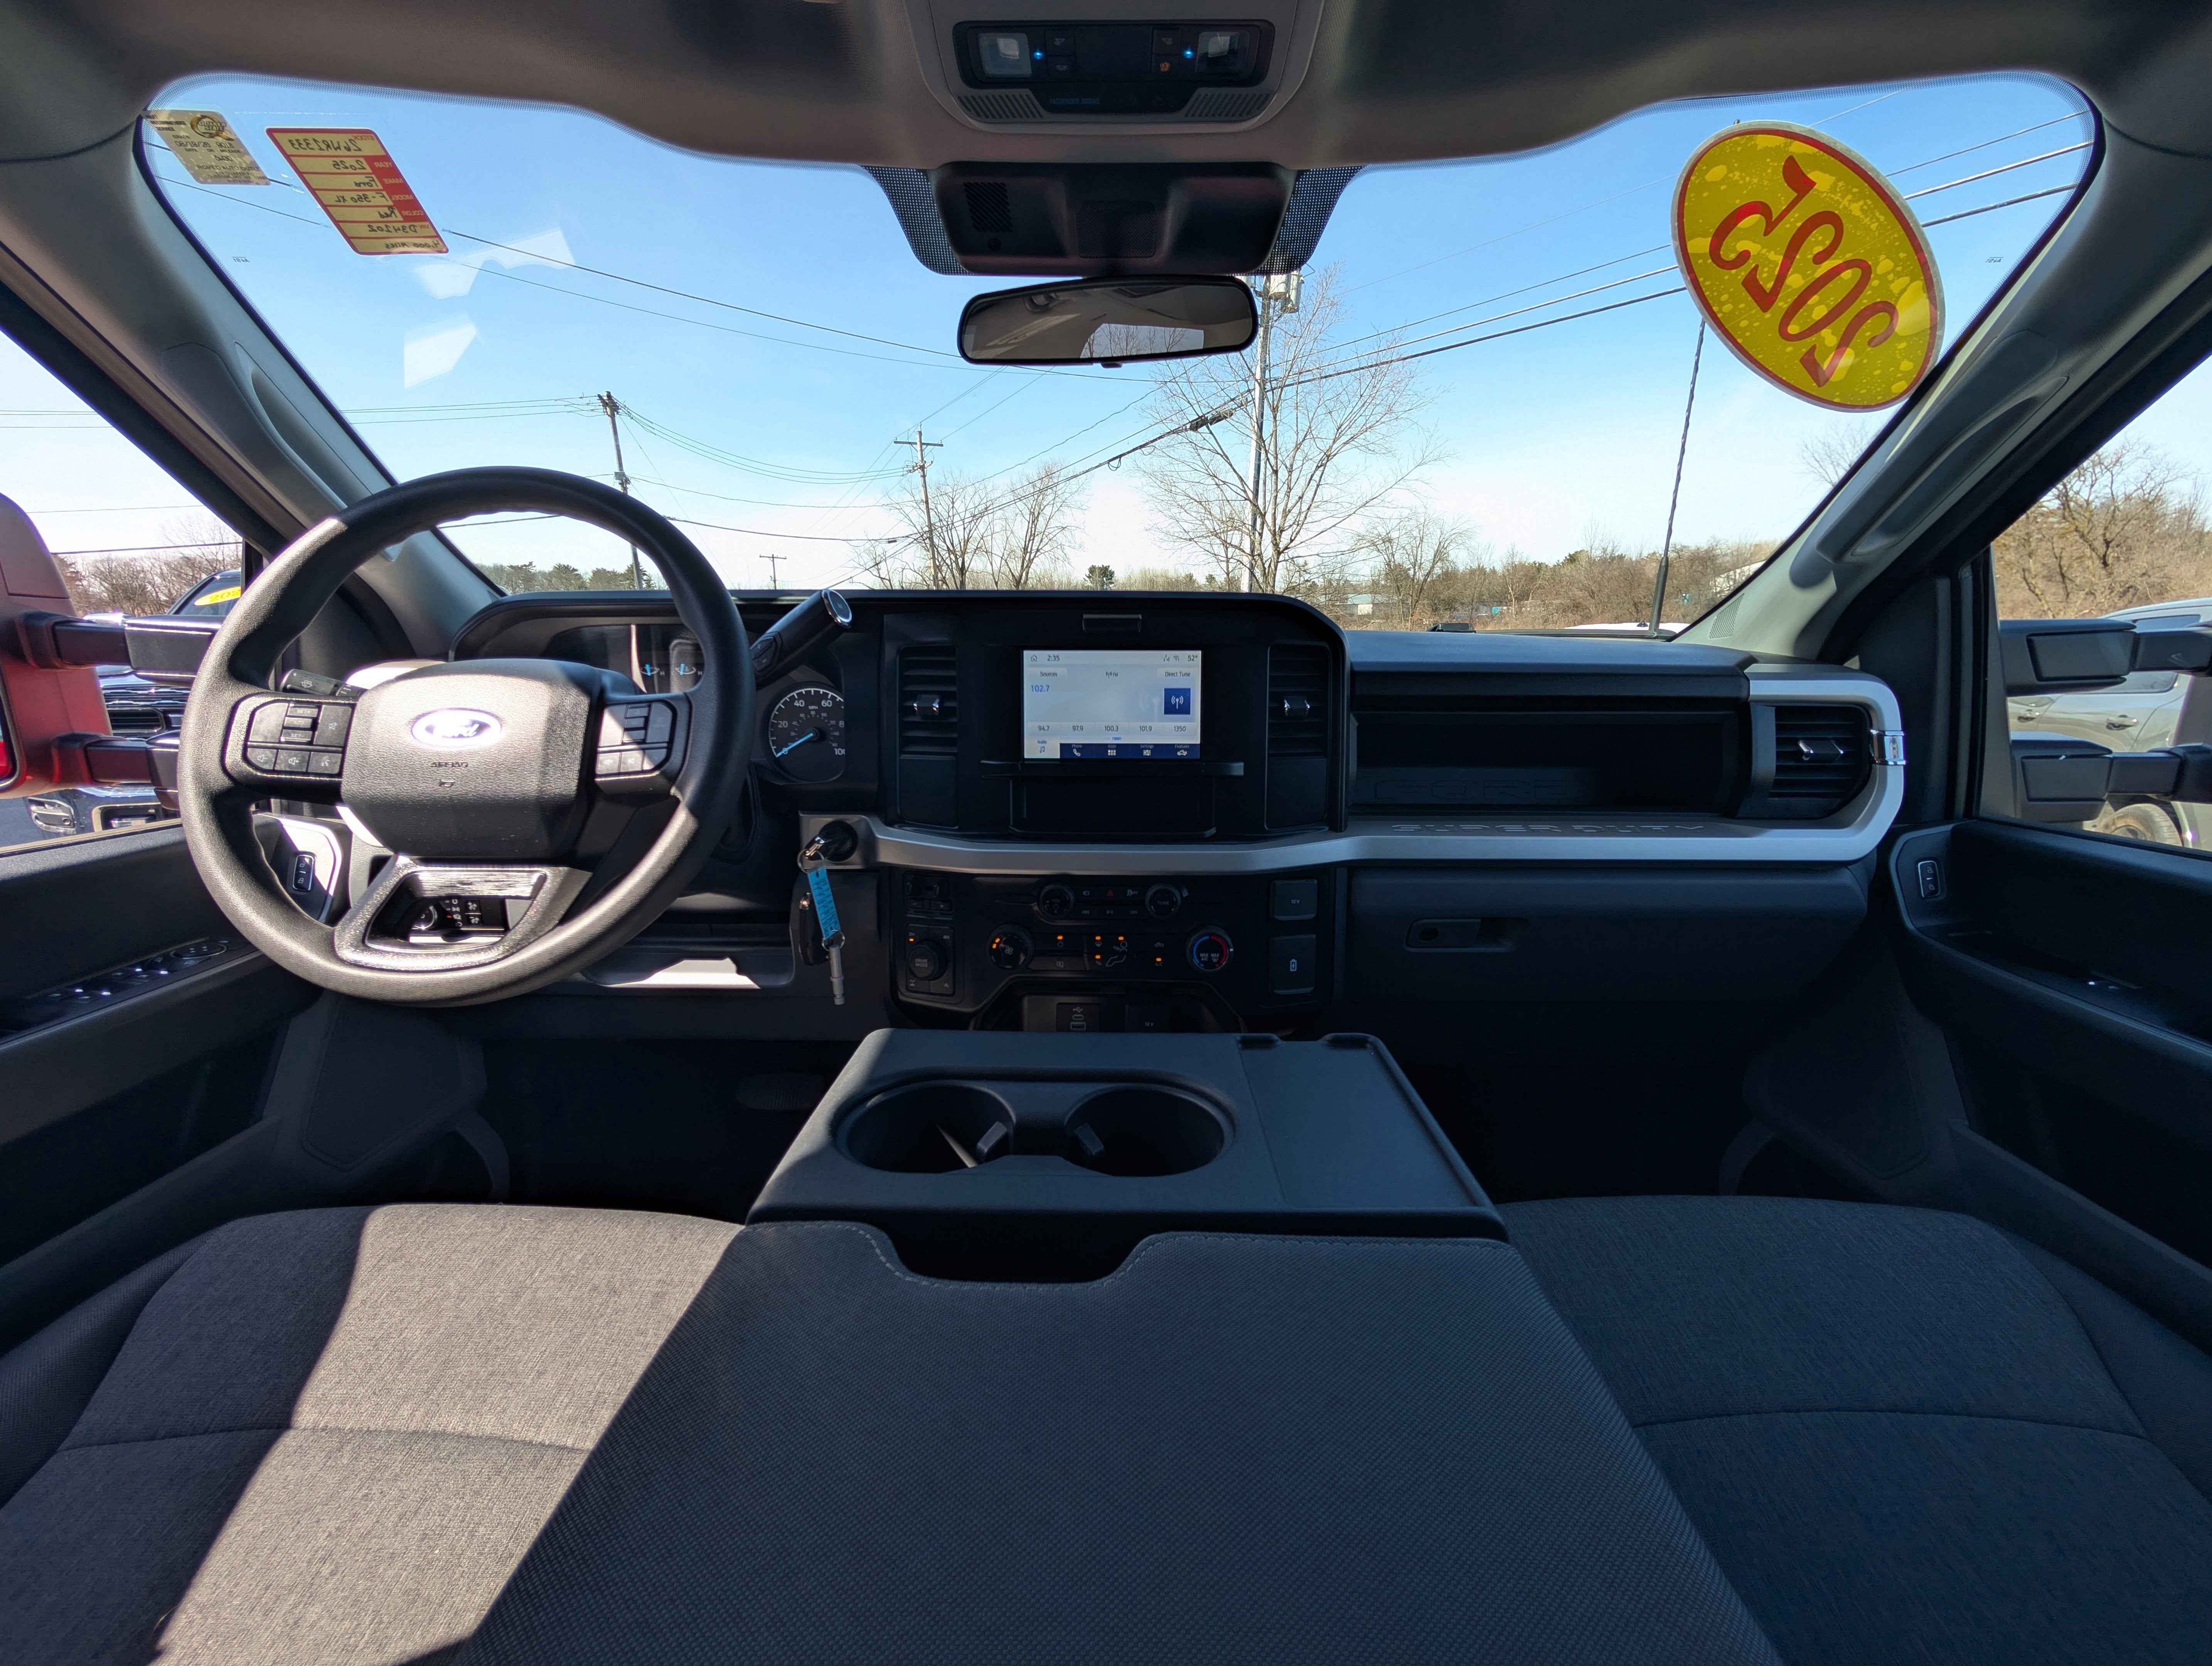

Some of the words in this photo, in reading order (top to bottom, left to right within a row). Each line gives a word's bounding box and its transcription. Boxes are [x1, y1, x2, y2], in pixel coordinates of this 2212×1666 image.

[210, 589, 241, 602] 202
[1031, 685, 1050, 693] 102.7
[1392, 825, 1562, 833] SUPER
[1571, 825, 1704, 833] DUTY
